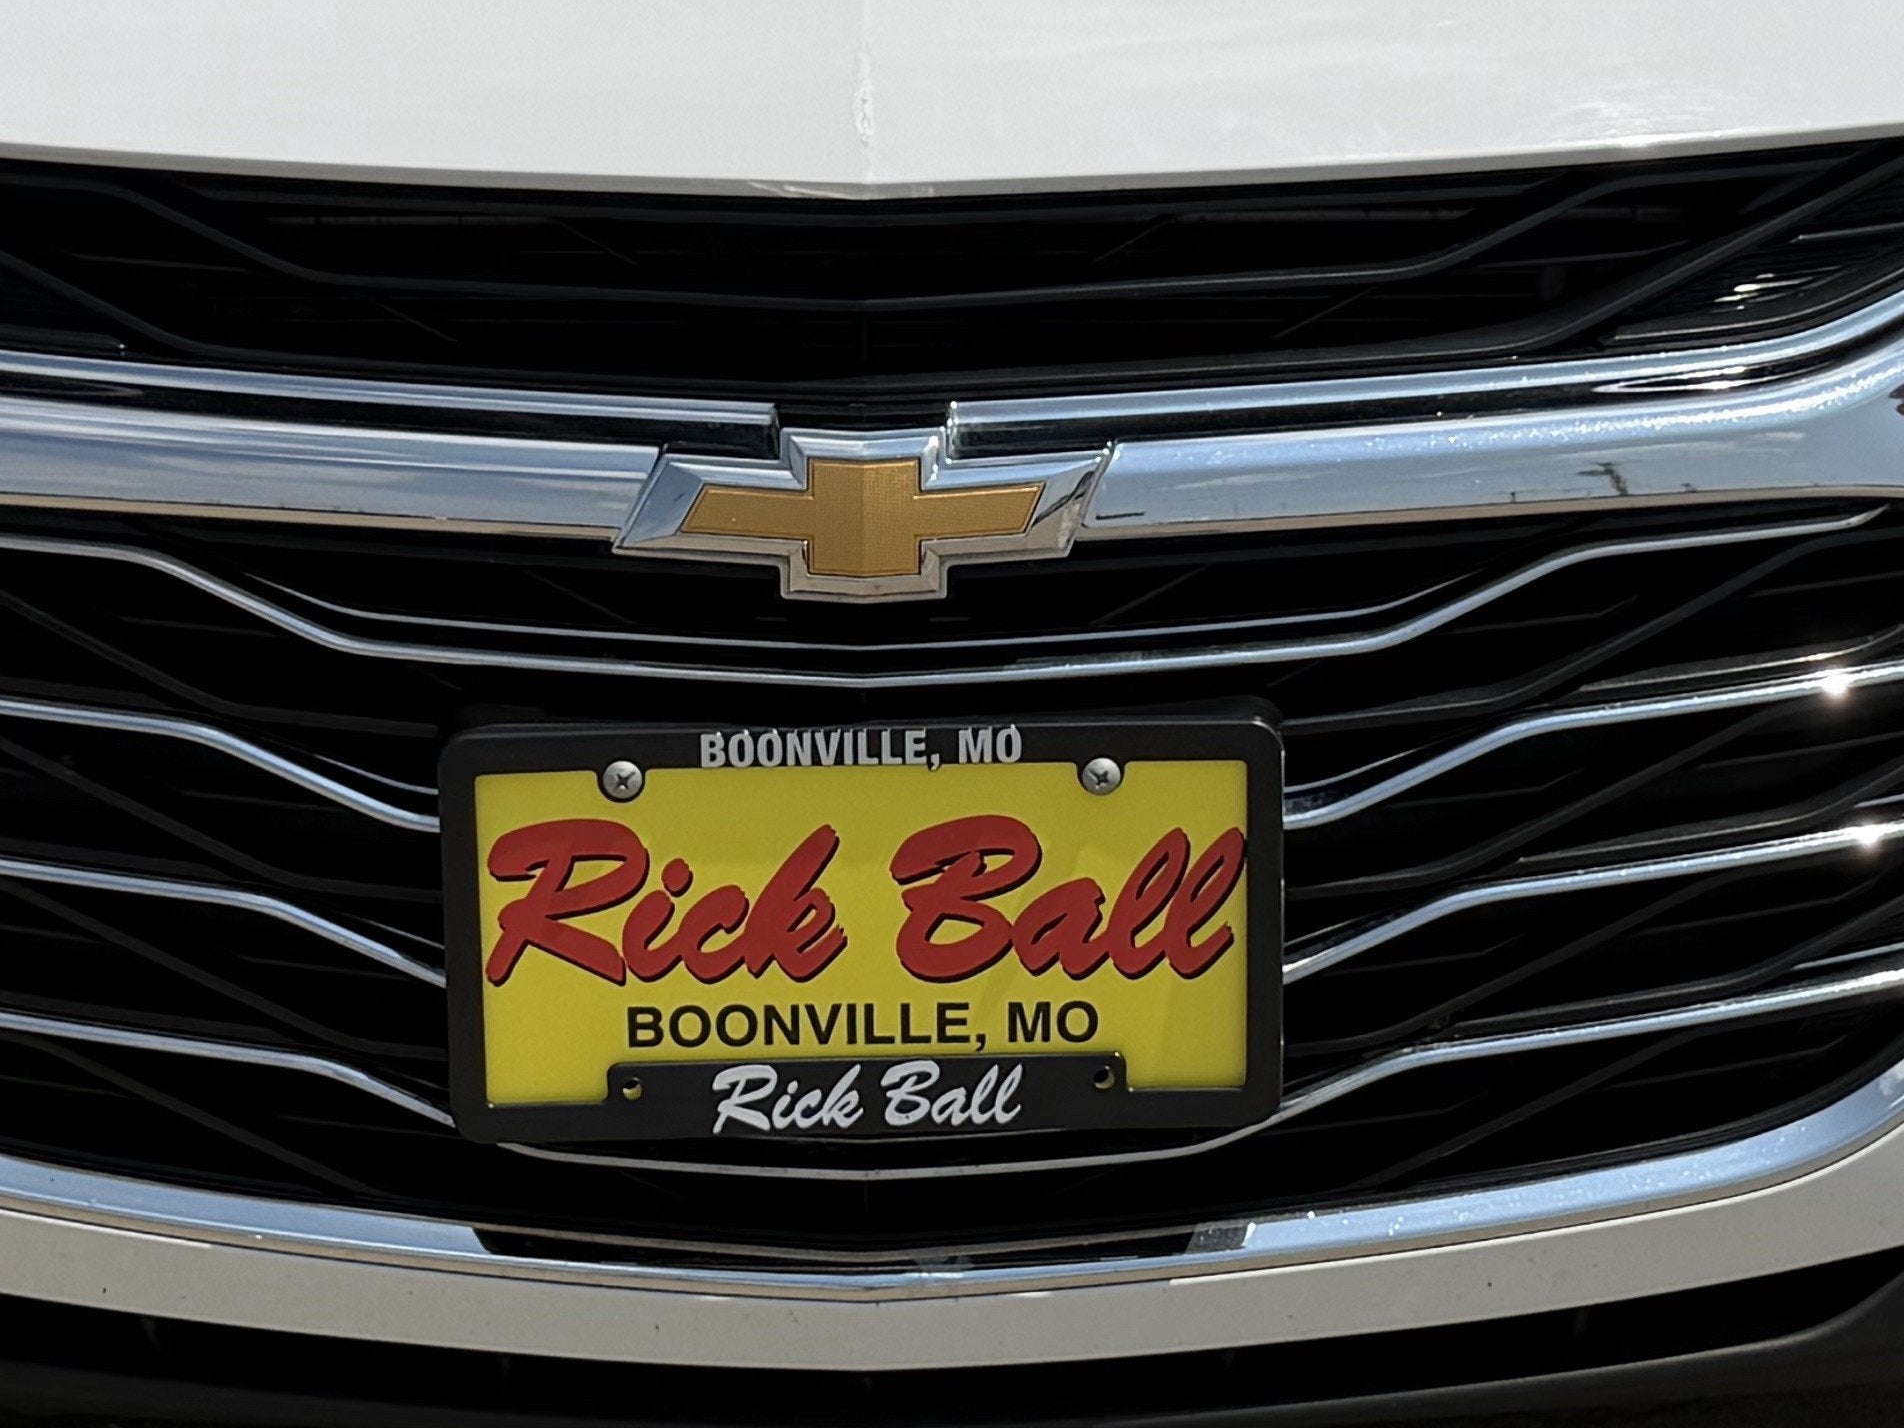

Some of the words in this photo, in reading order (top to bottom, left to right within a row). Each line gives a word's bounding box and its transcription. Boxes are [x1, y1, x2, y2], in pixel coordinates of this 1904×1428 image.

[698, 727, 942, 771] BOONVILLE,
[958, 723, 1023, 765] MO
[485, 817, 847, 987] Rick
[889, 814, 1247, 985] Ball
[626, 1000, 987, 1052] BOONVILLE,
[1006, 999, 1099, 1044] MO
[711, 1062, 864, 1135] Rick
[882, 1060, 1023, 1128] Ball
